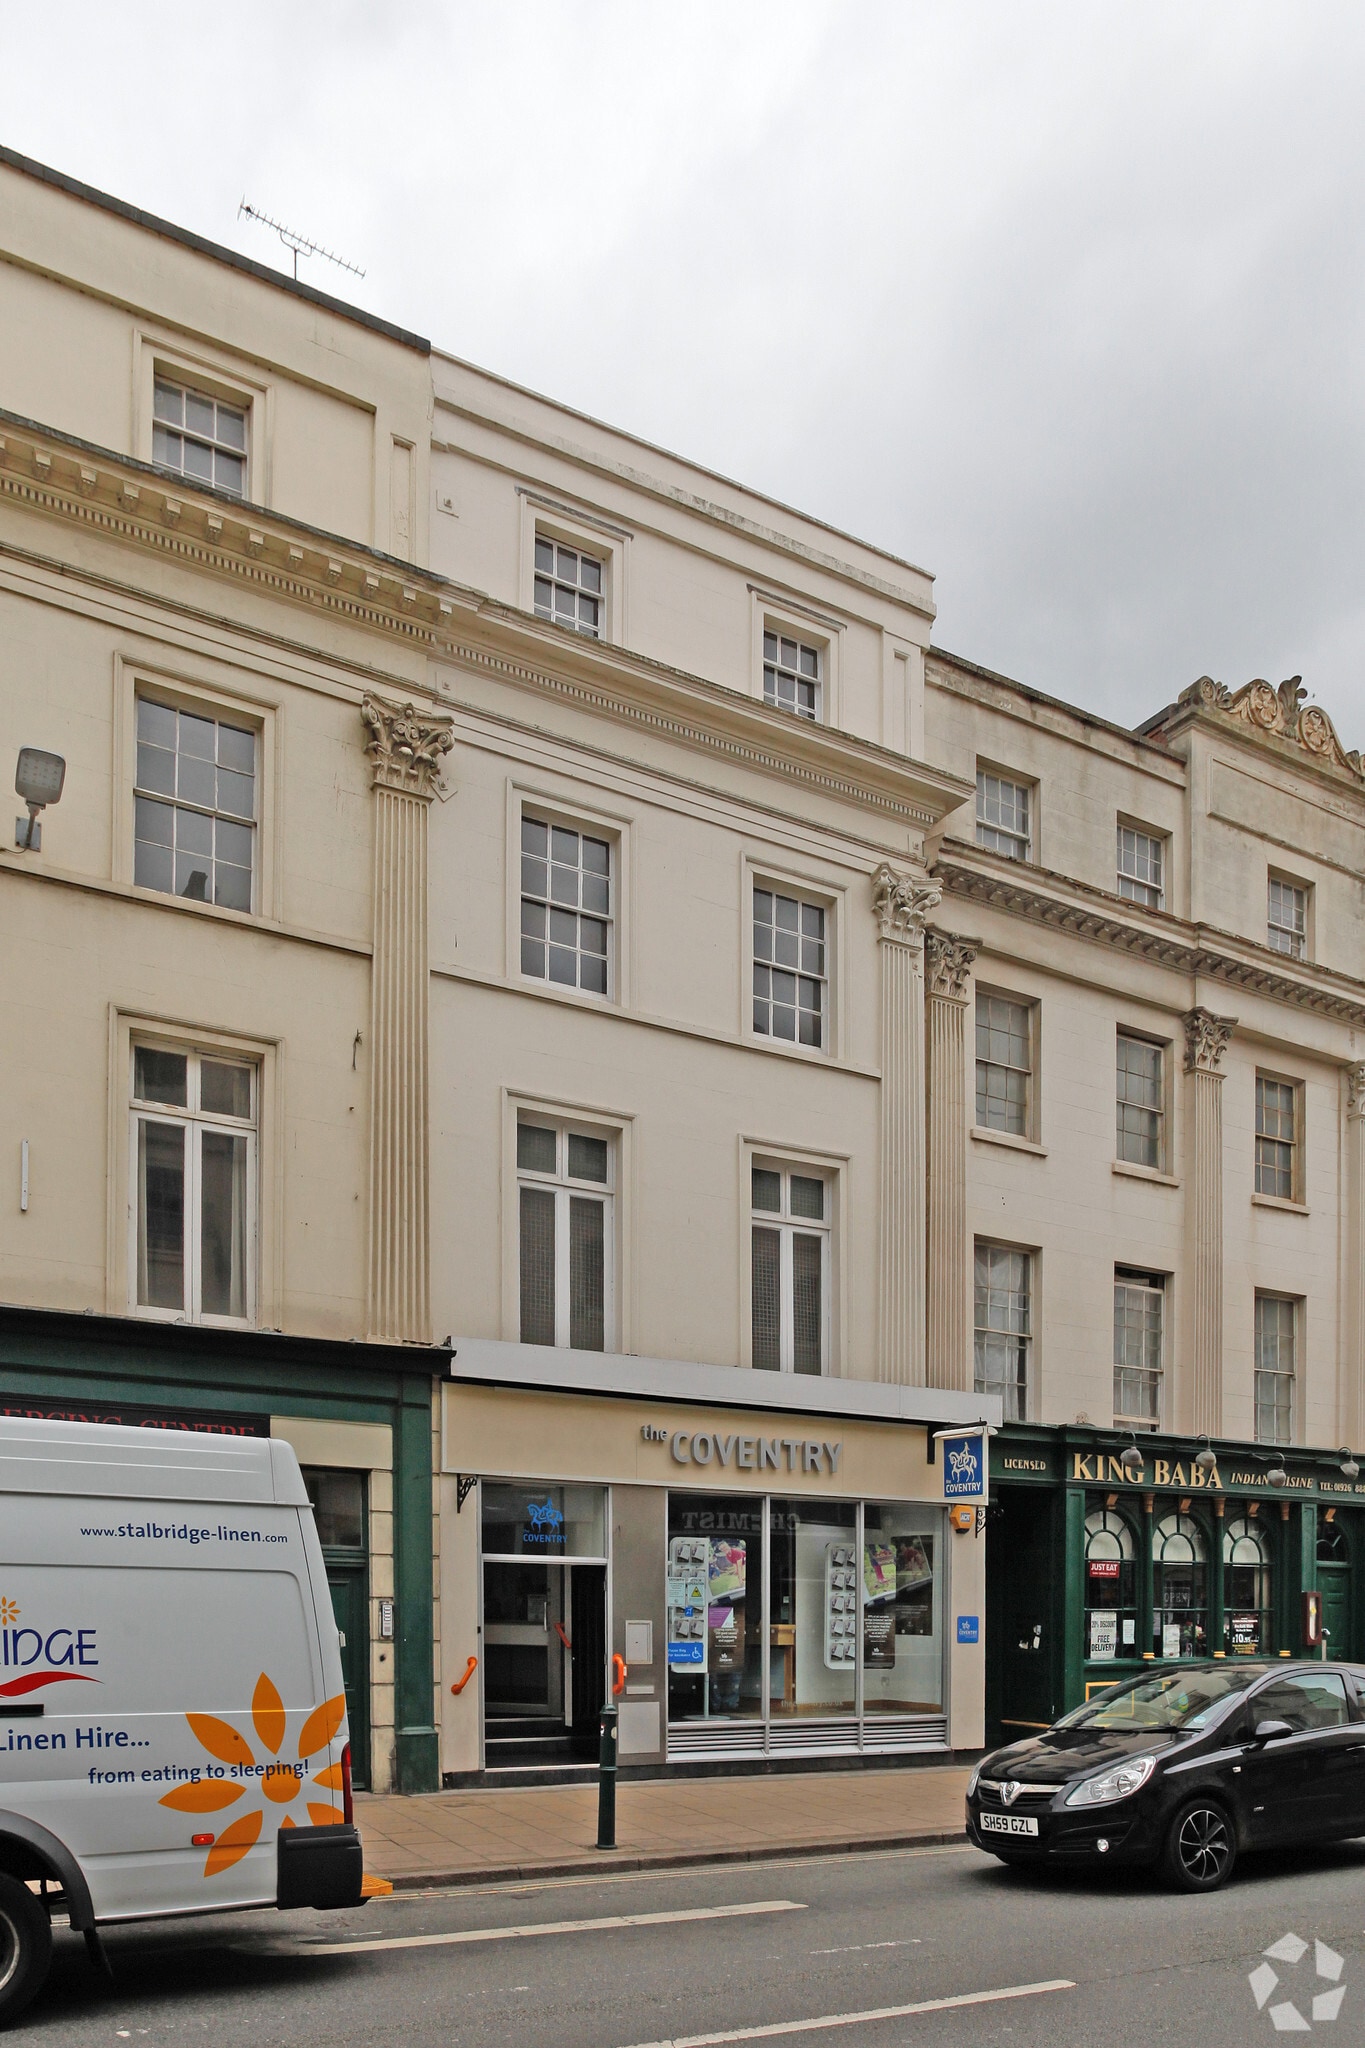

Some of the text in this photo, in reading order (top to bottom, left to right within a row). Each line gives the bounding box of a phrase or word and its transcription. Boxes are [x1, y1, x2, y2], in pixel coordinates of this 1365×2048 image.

[639, 1424, 842, 1474] the COVENTRY
[1004, 1458, 1047, 1471] LICENSED
[1071, 1452, 1224, 1490] KING BABA
[946, 1481, 981, 1493] COVENTRY
[1230, 1472, 1269, 1486] INDIAN
[80, 1522, 288, 1545] www.stalbridge-linen.com
[523, 1533, 567, 1543] COVENTRY
[1090, 1563, 1118, 1572] JUST EAT
[1097, 1634, 1110, 1643] FREE
[0, 1628, 100, 1666] IDGE
[1091, 1643, 1114, 1652] DELIVERY
[0, 1726, 150, 1751] inen Hire...
[87, 1758, 310, 1785] from eating to sleeping!
[983, 1815, 1033, 1833] SH59 GZL
